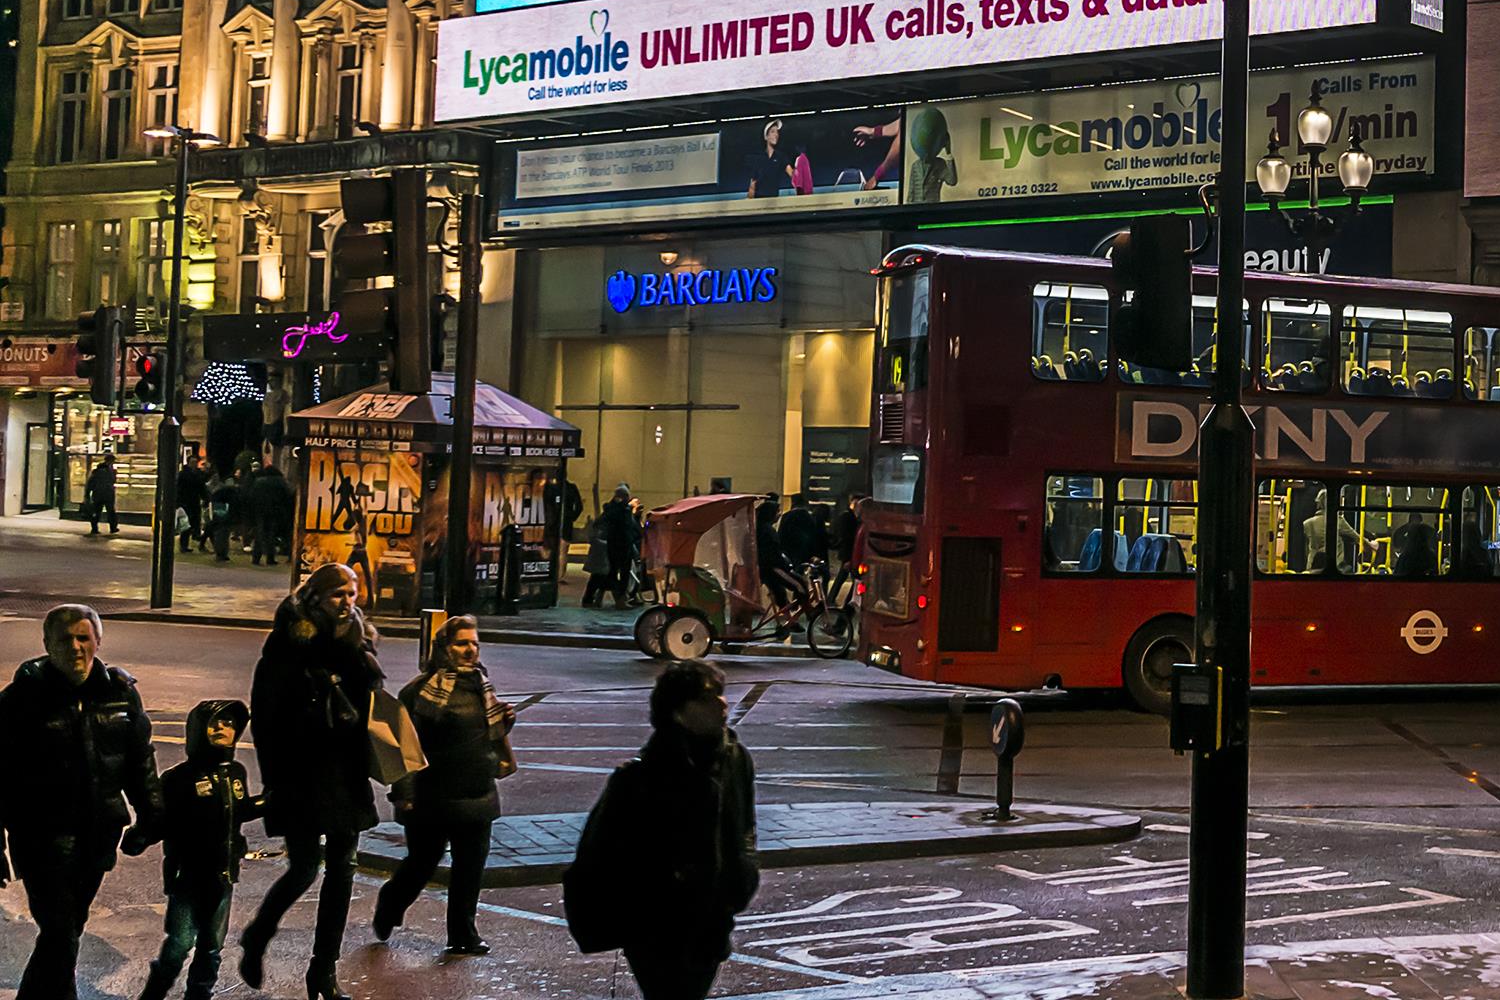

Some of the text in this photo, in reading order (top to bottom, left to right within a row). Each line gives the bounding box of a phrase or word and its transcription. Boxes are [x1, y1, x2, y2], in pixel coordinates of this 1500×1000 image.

[463, 33, 629, 95] Lycamobile
[640, 10, 815, 69] UNLIMITED
[826, 3, 875, 48] UK
[528, 76, 628, 100] Call the world for less
[1316, 72, 1418, 95] Calls From
[1265, 92, 1418, 156] 1/min
[1104, 156, 1128, 172] Call
[1130, 154, 1149, 170] the
[1151, 152, 1187, 169] world
[1189, 151, 1208, 167] for
[978, 173, 1222, 198] 020 7132 0322 www.lycamobile.co
[1243, 246, 1331, 275] eauty
[640, 267, 778, 307] BARCLAYS
[305, 437, 329, 447] HALF
[331, 438, 357, 448] PRICE
[1131, 401, 1390, 464] DNY
